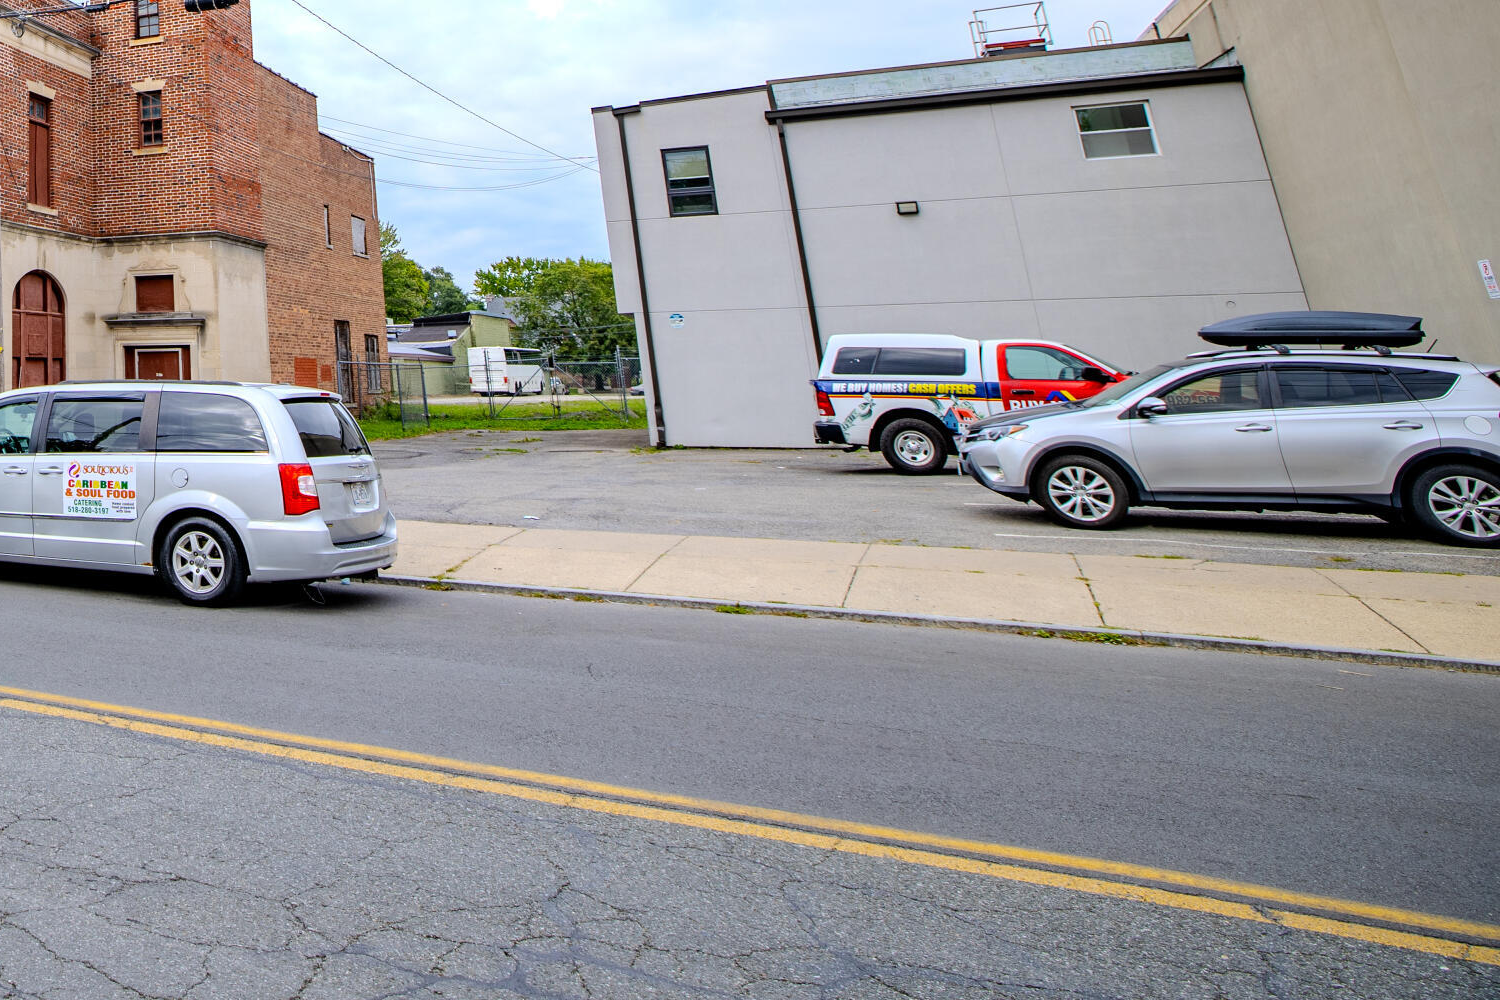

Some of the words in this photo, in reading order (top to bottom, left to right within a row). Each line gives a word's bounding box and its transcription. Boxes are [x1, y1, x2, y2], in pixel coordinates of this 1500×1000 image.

[832, 383, 847, 393] WE
[847, 383, 868, 393] BUY
[869, 383, 907, 393] HOMES!
[908, 384, 936, 394] CASH
[937, 384, 976, 395] OFFERS
[68, 479, 128, 489] CARIBBEAN
[65, 488, 73, 496] &
[76, 489, 103, 498] SOUL
[106, 490, 136, 499] FOOD
[74, 499, 102, 507] CATERING
